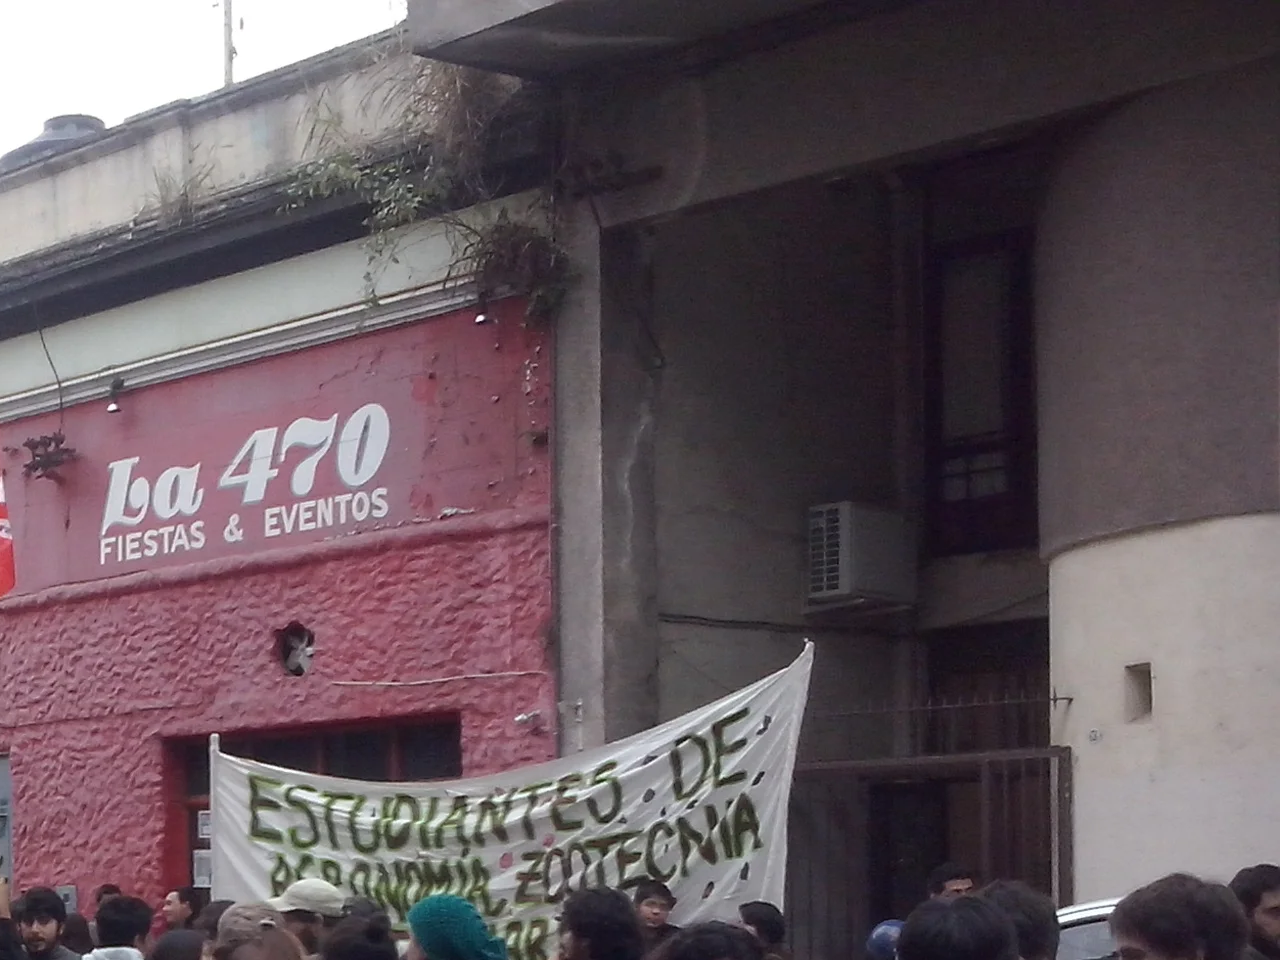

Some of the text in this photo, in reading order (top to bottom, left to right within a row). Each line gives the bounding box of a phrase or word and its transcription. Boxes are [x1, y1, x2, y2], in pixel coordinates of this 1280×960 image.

[100, 487, 389, 565] FIESTAS & EVENTOS
[101, 402, 391, 535] La 470
[247, 706, 750, 854] ESTUDIANTES DE
[514, 793, 764, 904] ZOOTECNIA
